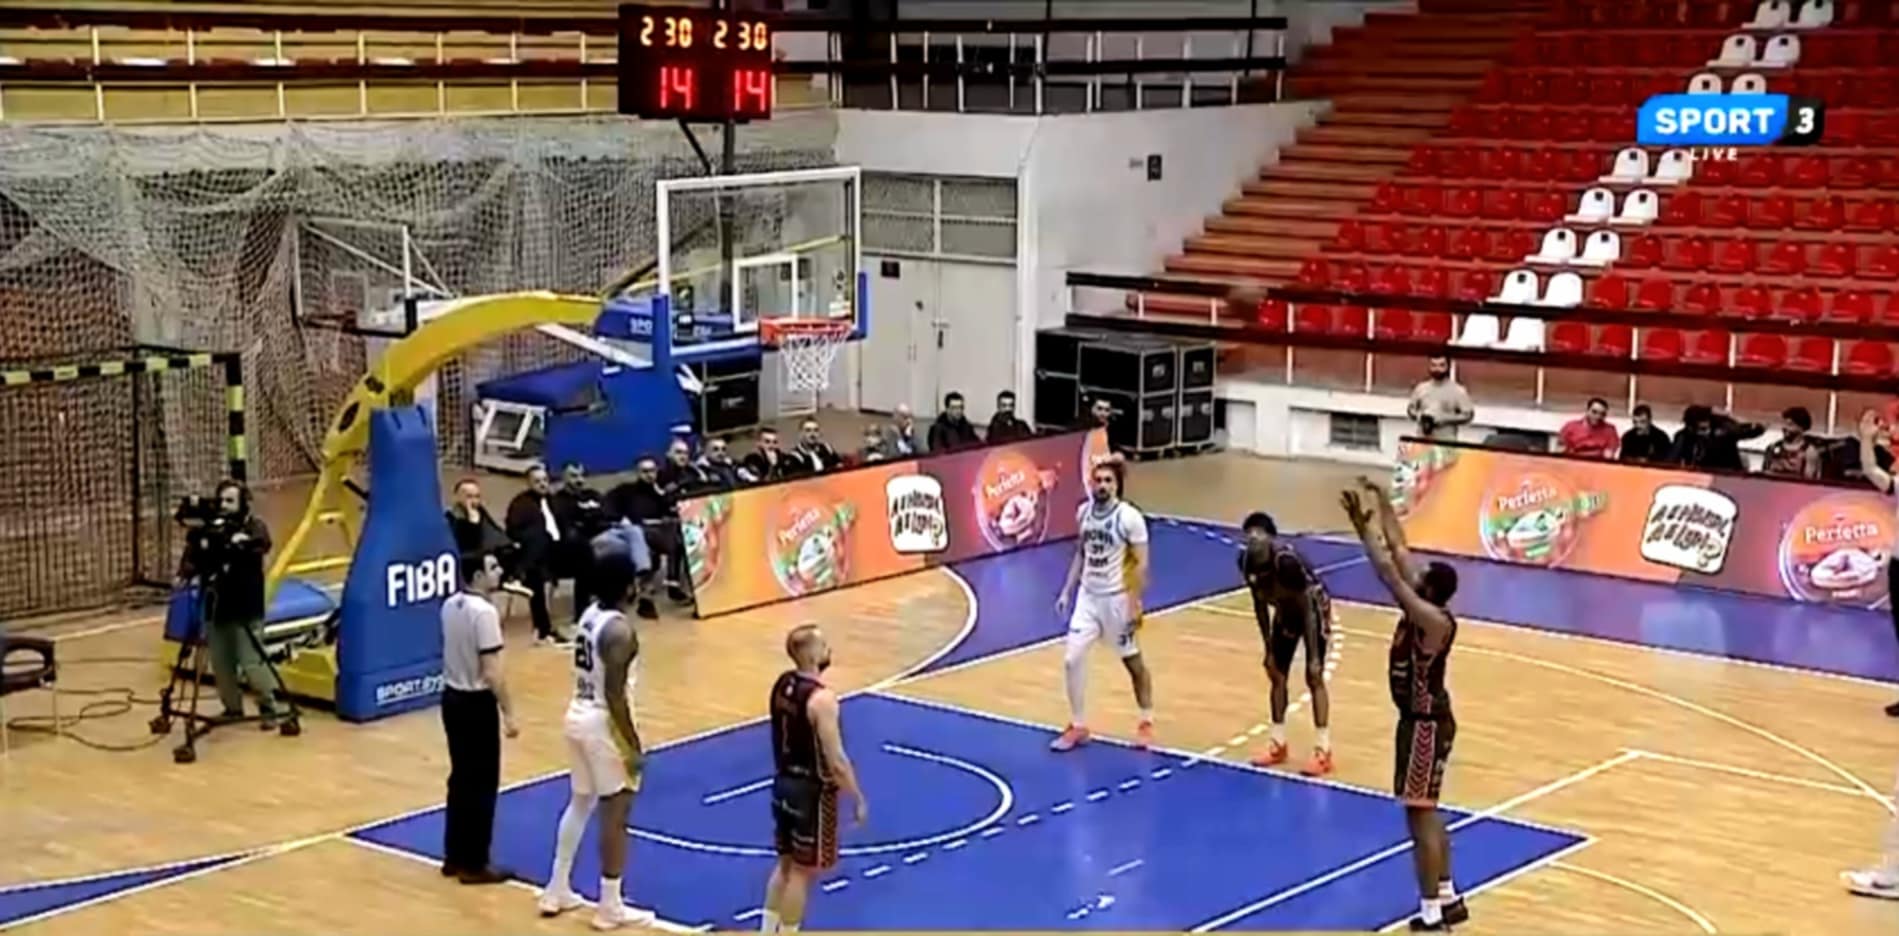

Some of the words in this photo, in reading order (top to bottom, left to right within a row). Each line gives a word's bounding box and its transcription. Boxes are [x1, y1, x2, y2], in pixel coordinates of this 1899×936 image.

[640, 16, 654, 46] 2
[665, 17, 692, 48] 30
[713, 20, 728, 48] 2
[738, 22, 767, 50] 30
[660, 66, 693, 109] 14
[734, 69, 767, 111] 14
[1804, 521, 1878, 545] Perfetta
[387, 553, 457, 607] FIBA
